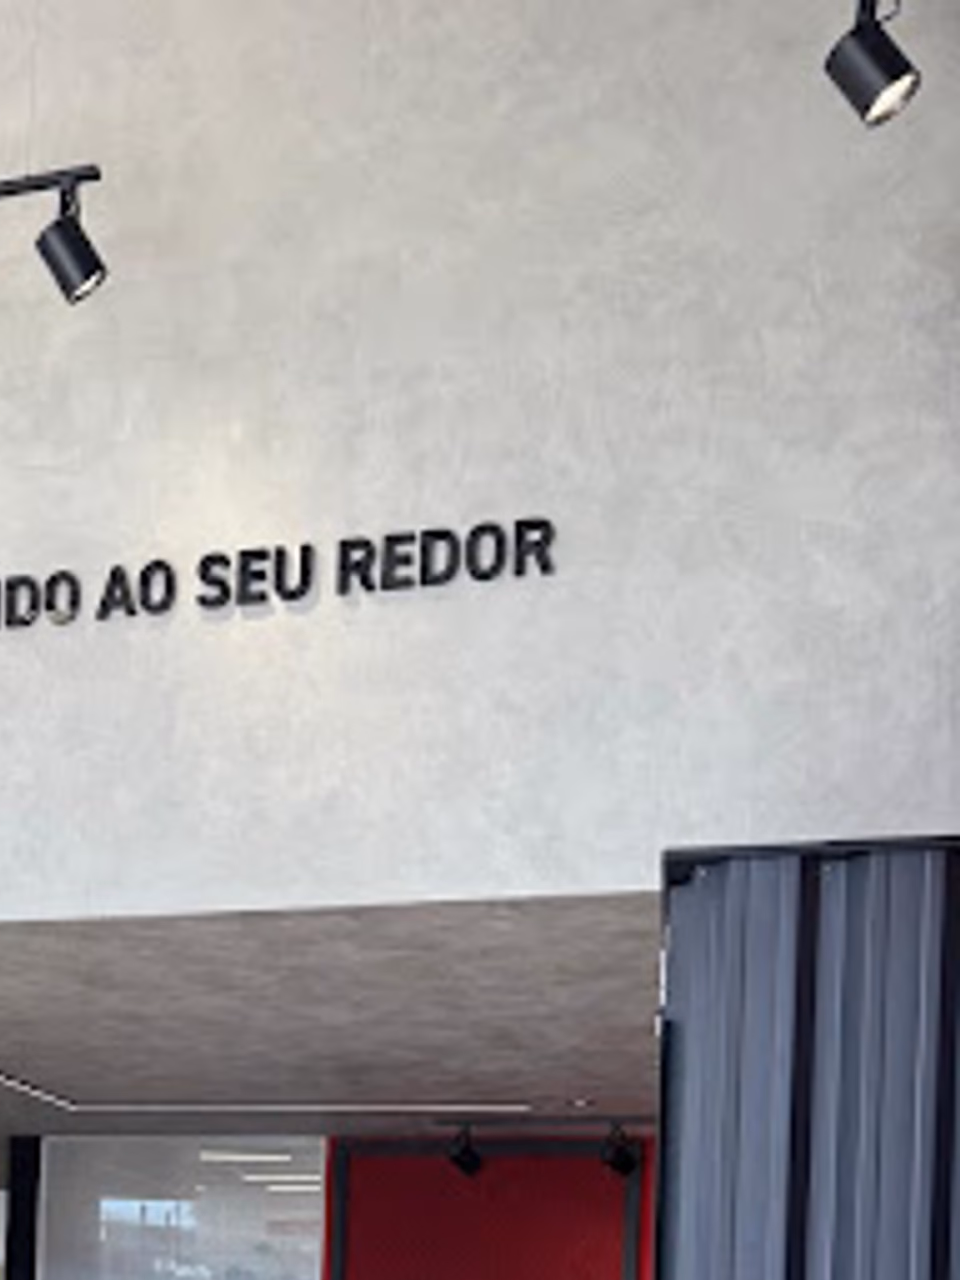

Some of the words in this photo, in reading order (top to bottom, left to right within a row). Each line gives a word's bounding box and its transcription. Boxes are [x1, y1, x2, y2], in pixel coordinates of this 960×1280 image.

[95, 560, 177, 621] AO
[196, 543, 316, 609] SEU
[336, 518, 556, 597] REDOR
